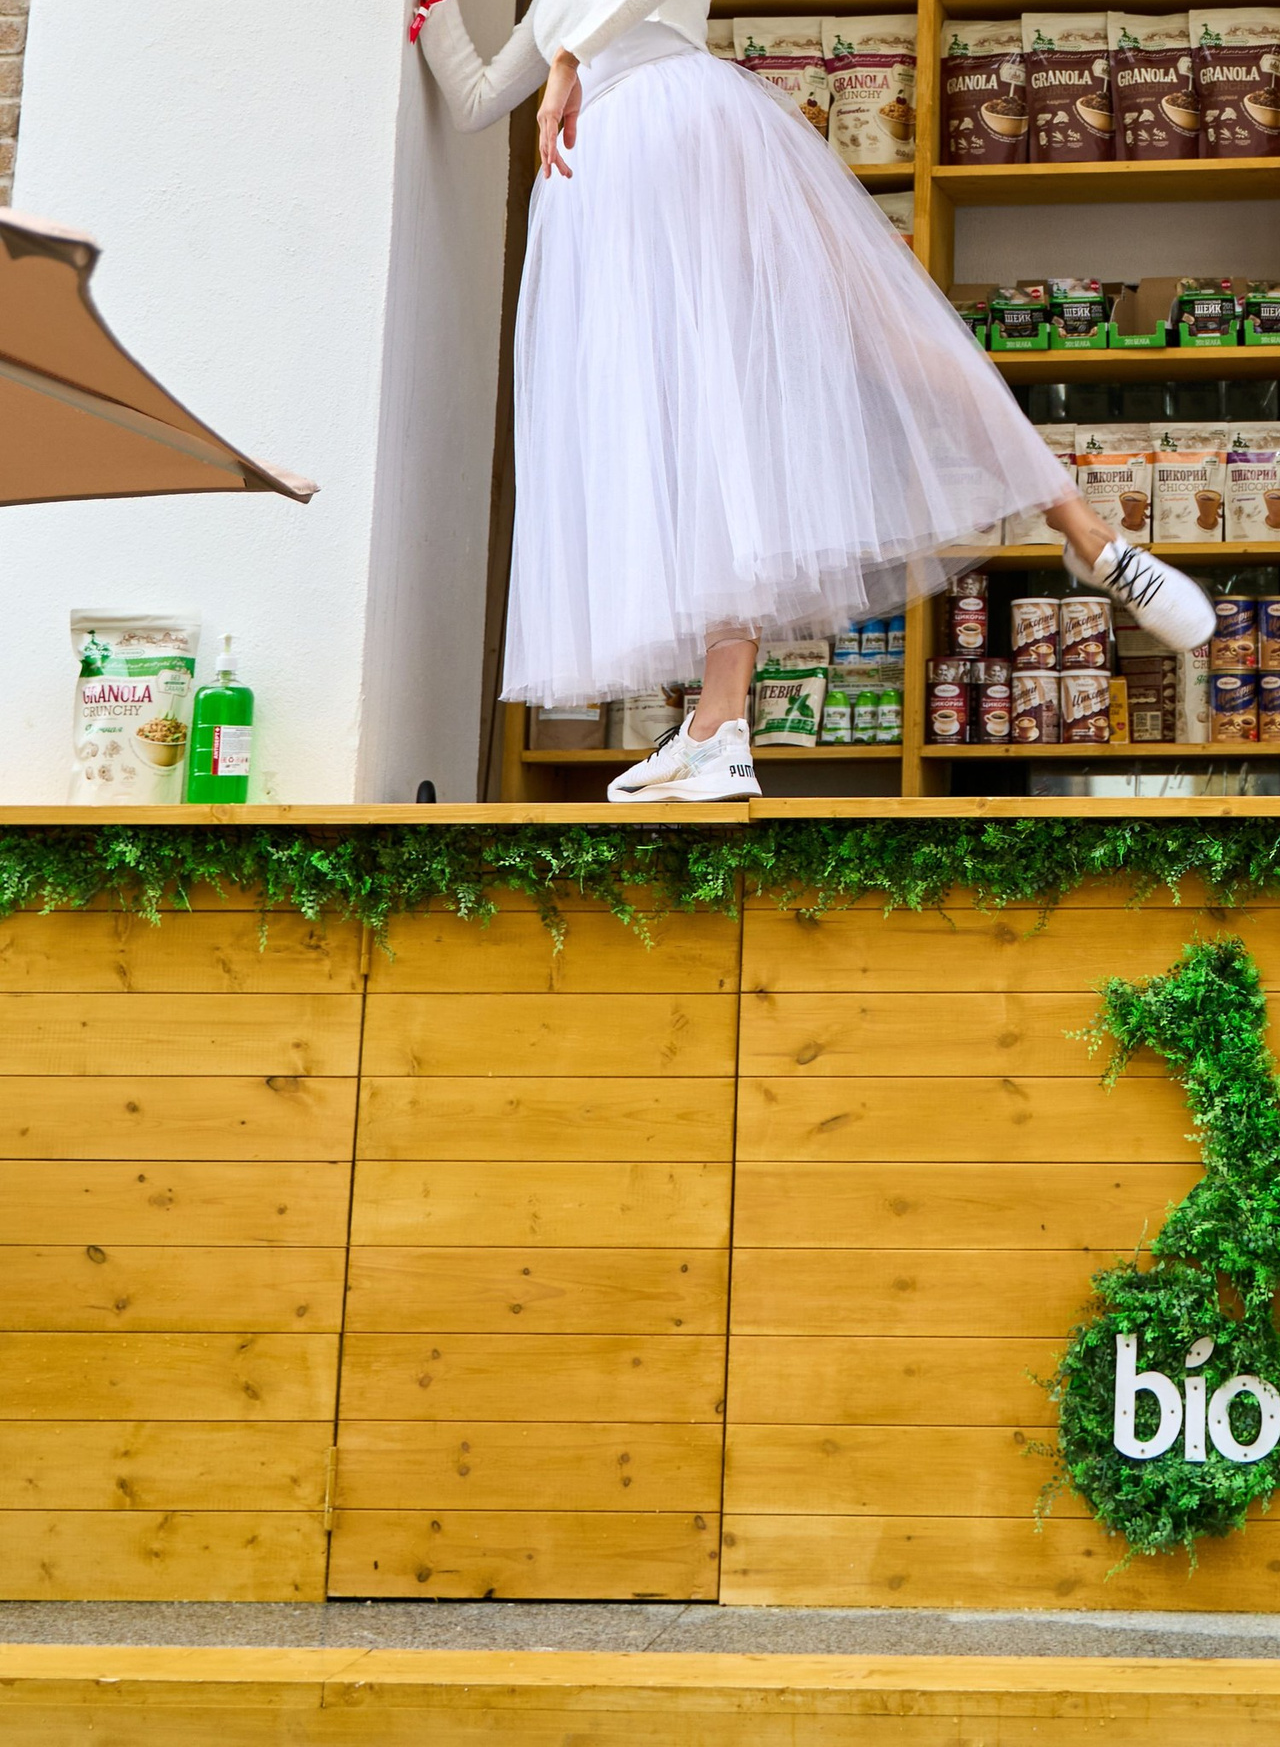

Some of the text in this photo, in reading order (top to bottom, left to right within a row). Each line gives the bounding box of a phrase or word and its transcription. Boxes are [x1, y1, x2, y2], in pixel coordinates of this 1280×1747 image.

[1032, 70, 1092, 88] GRANOLA
[1118, 68, 1178, 87] GRANOLA
[1200, 66, 1260, 84] GRANOLA
[834, 75, 890, 93] GRANOLA
[947, 74, 998, 95] GRANOLA
[1064, 308, 1090, 317] ШЕЙК
[1195, 304, 1221, 313] ШЕЙК
[1005, 314, 1031, 323] ШЕЙК
[1087, 469, 1133, 484] ЦИКОРИЙ
[1159, 467, 1207, 486] ЦИКОРИЙ
[1231, 469, 1277, 486] ЦИКОРИЙ
[83, 684, 152, 705] GRANOLA
[761, 684, 802, 700] ТЕВИЯ
[83, 705, 142, 718] CRUNCHY
[730, 764, 755, 777] PUM
